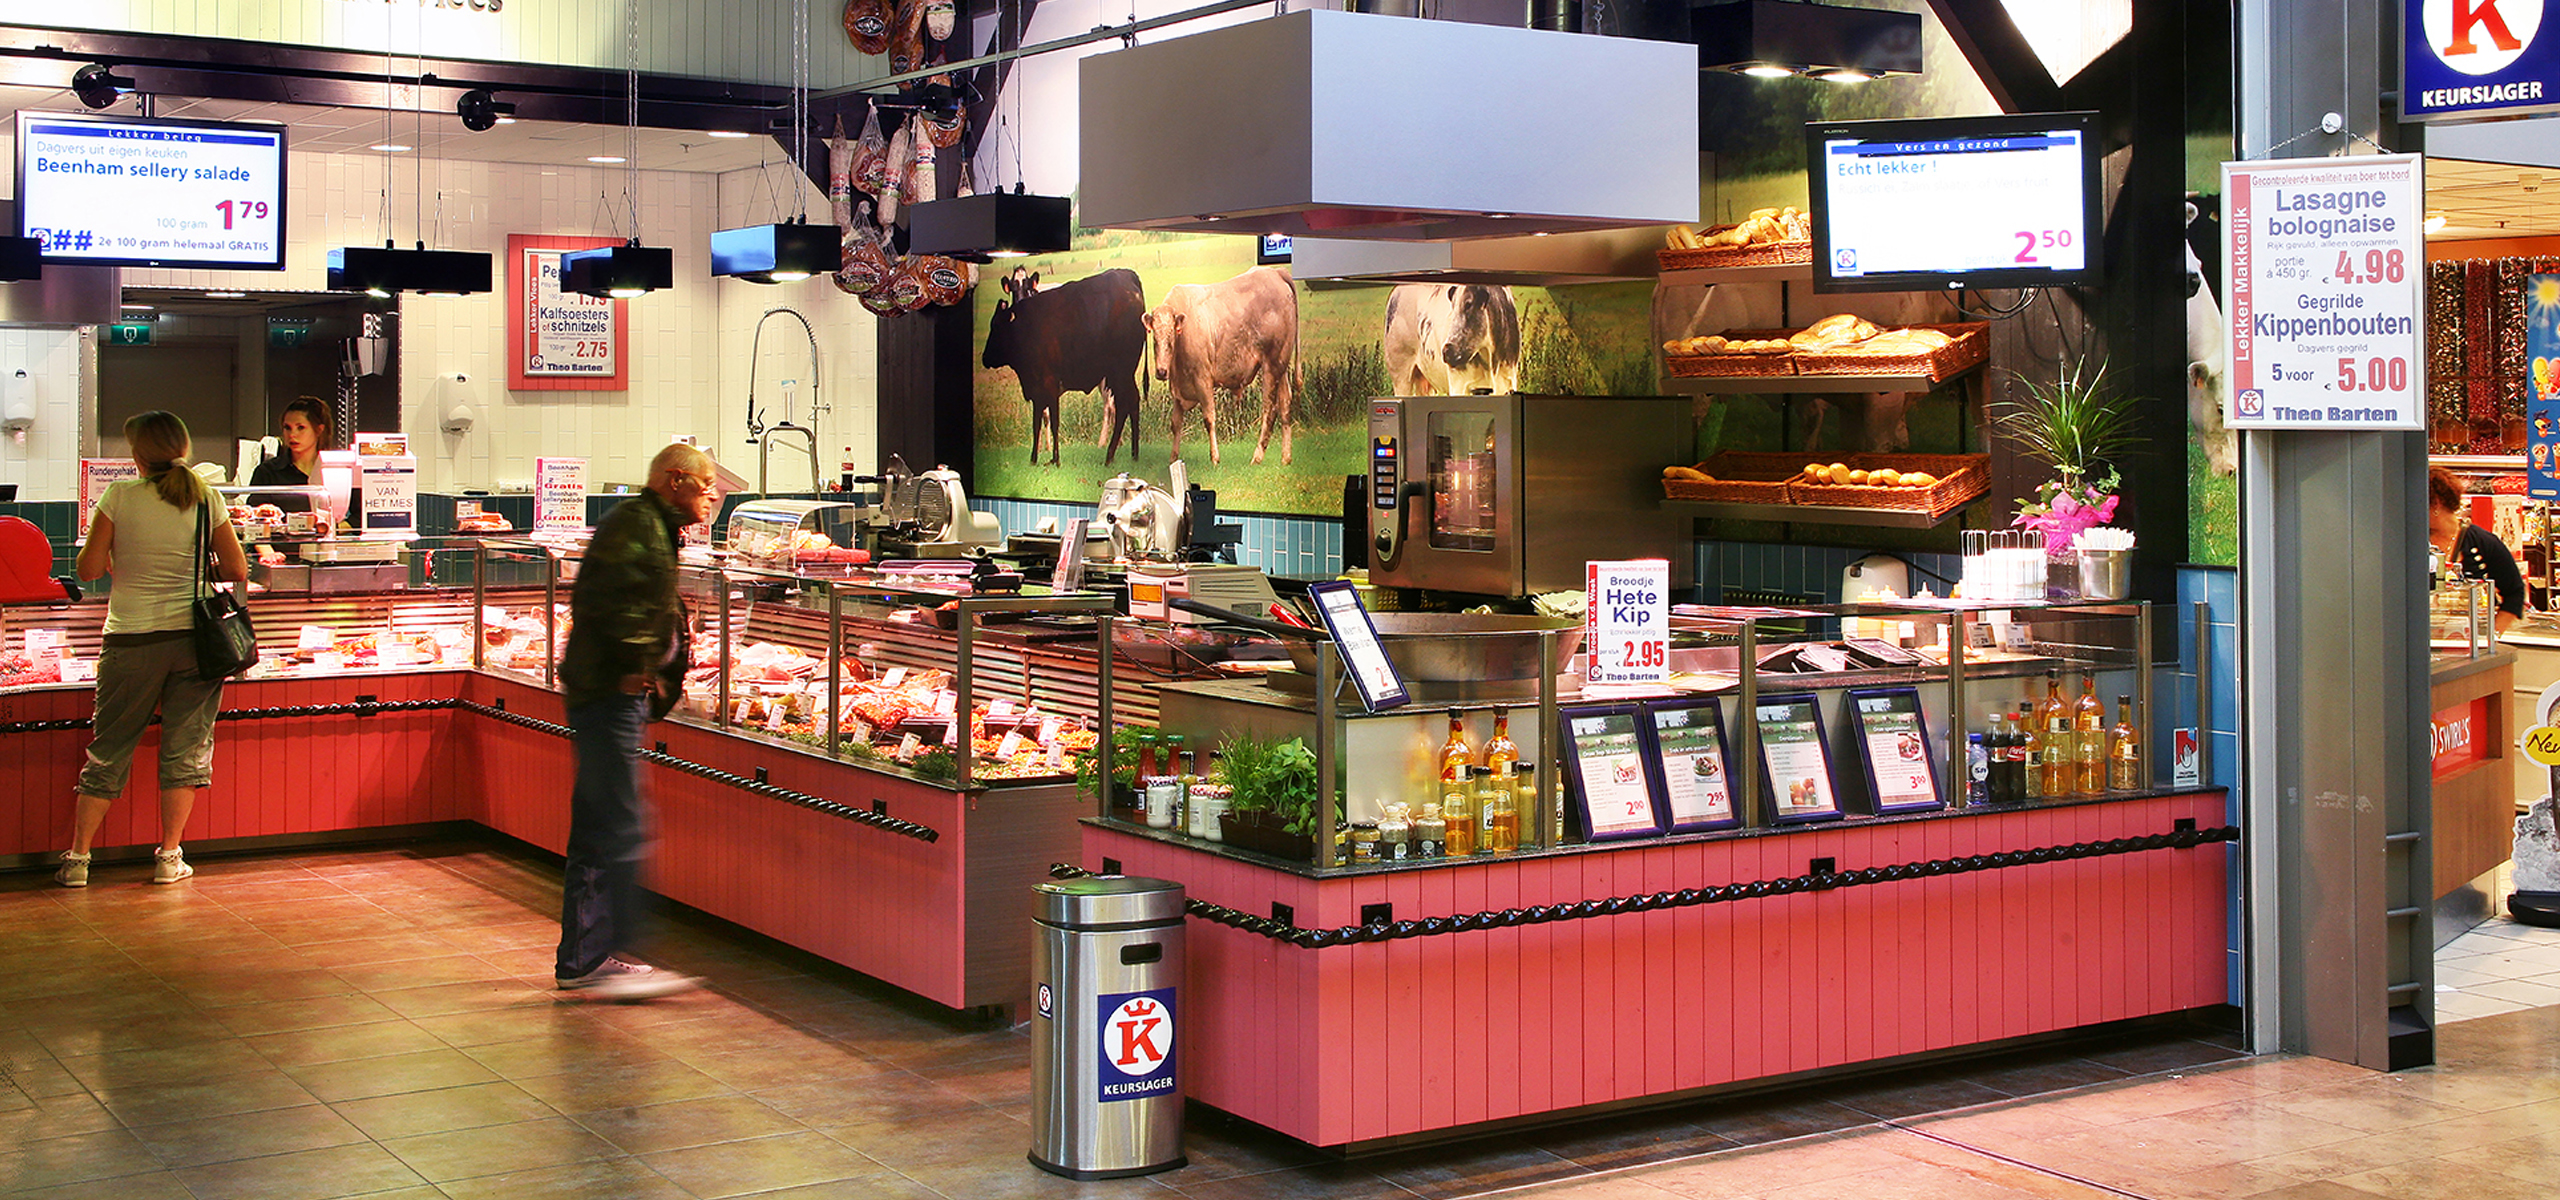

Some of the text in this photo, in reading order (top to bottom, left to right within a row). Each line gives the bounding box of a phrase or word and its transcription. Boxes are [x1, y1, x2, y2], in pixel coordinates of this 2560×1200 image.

[2444, 0, 2522, 56] K
[2422, 81, 2543, 108] KEURSLAGER
[108, 129, 156, 140] Lekker
[37, 141, 188, 159] Dagvers uit eigen keuken
[1895, 139, 2010, 151] Vers en gezond
[37, 158, 251, 182] Beenham sellery salade
[1838, 162, 1871, 176] Echt
[1877, 161, 1927, 175] lekker
[2252, 169, 2410, 186] Gecontroleerde kwaliteit van boer tot bord
[2276, 189, 2386, 215] Lasagne
[156, 218, 208, 232] 100 gram
[2269, 214, 2396, 239] bolognaise
[98, 237, 112, 247] 2e
[117, 237, 137, 248] 100
[140, 240, 170, 252] gram
[173, 239, 225, 250] helemaal
[228, 241, 269, 251] GRATIS
[2267, 241, 2284, 251] Rijk
[2320, 240, 2348, 248] alleen
[2350, 238, 2399, 249] opwarmen
[2275, 256, 2304, 268] portie
[2335, 249, 2404, 284] 4.98
[2276, 268, 2296, 279] 450
[2299, 269, 2312, 280] gr.
[2234, 207, 2250, 361] Lekker Makkelijk
[2298, 294, 2364, 312] Gegrilde
[540, 307, 609, 320] Kalfsoesters
[542, 320, 607, 332] of schnitzels
[2254, 312, 2412, 342] Kippenbouten
[577, 341, 607, 358] 2.75
[2297, 344, 2368, 354] Dagvers gegrild
[2272, 363, 2282, 381] 5
[2285, 371, 2314, 381] voor
[2338, 357, 2407, 392] 5.00
[2273, 407, 2398, 421] Theo Barten
[89, 466, 136, 477] Rundergehakt
[376, 487, 399, 496] VAN
[365, 499, 413, 508] HET MES
[1610, 576, 1654, 588] Broodje
[1607, 589, 1657, 605] Hete
[1613, 607, 1650, 626] Kip
[1623, 640, 1664, 667] 2.95
[1606, 673, 1660, 681] Theo Barten
[1117, 1018, 1162, 1065] K
[1104, 1077, 1173, 1095] KEURSLAGER
